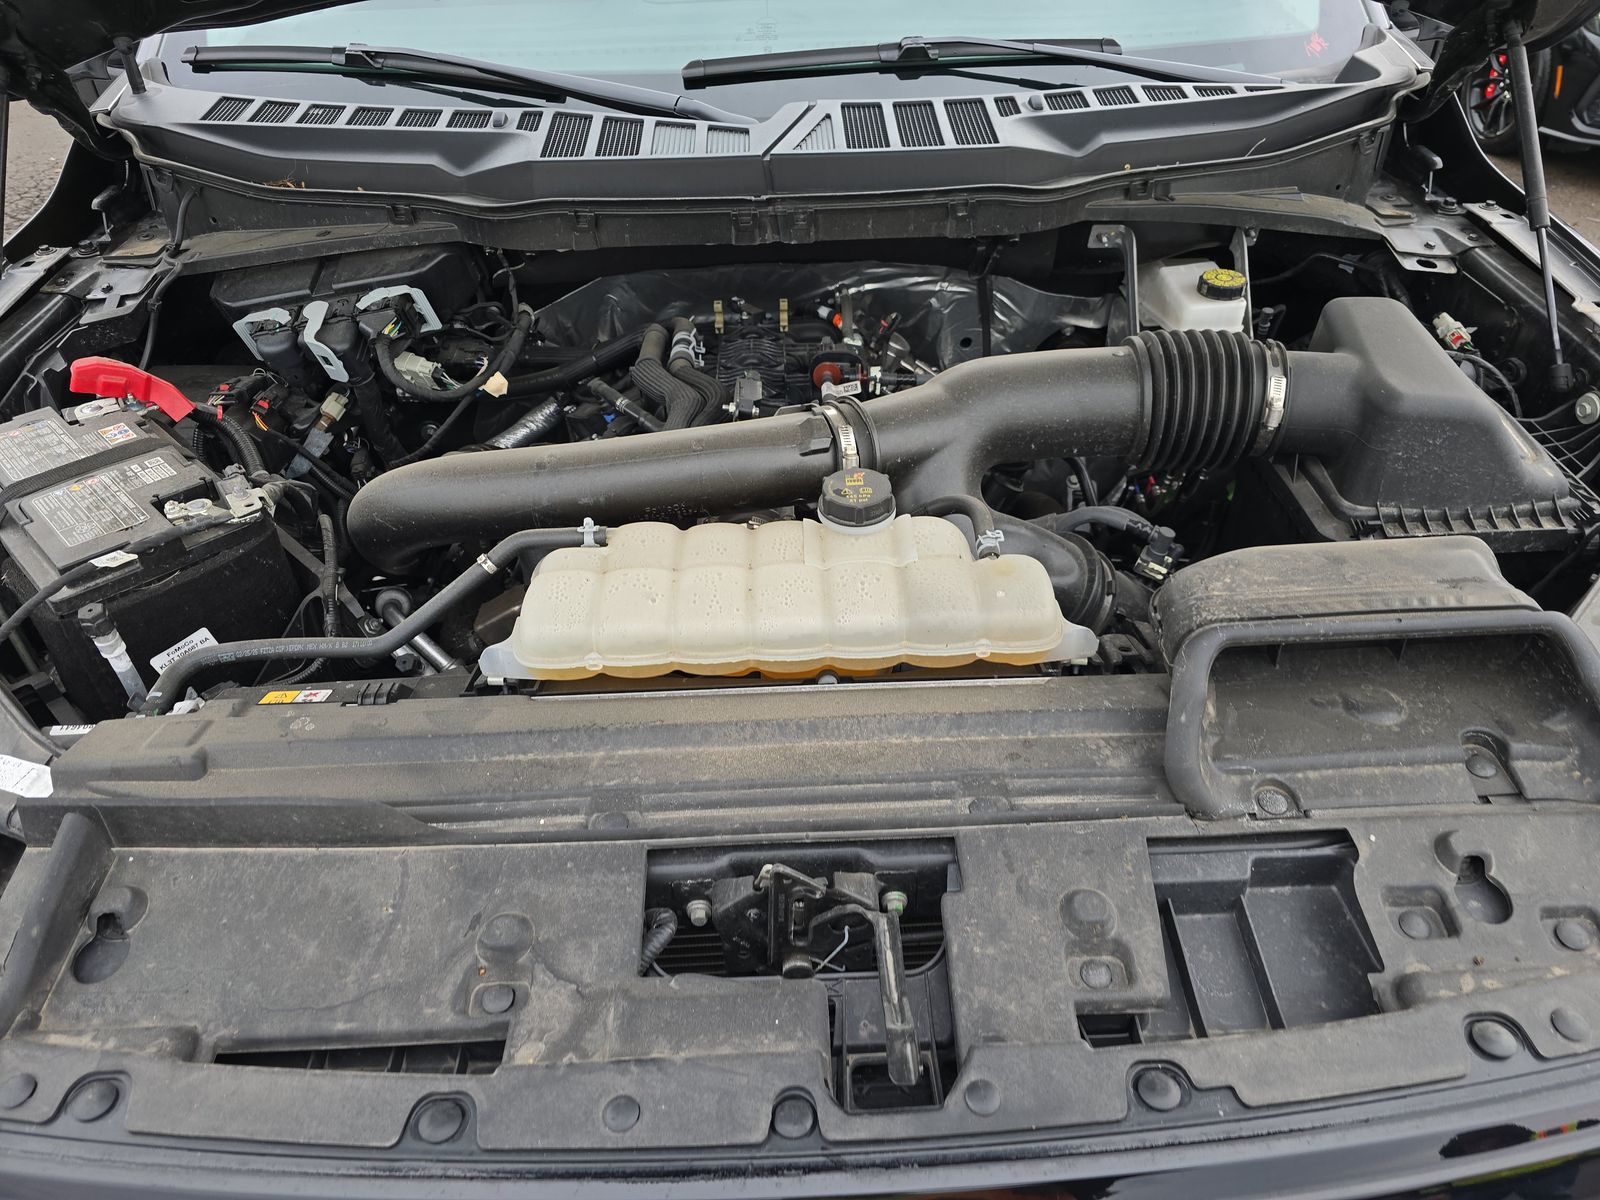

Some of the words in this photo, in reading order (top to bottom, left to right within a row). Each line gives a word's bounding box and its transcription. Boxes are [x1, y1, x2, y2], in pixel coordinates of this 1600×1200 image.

[160, 657, 176, 670] KL3T
[200, 637, 210, 645] BA
[166, 639, 194, 657] FoMoCo
